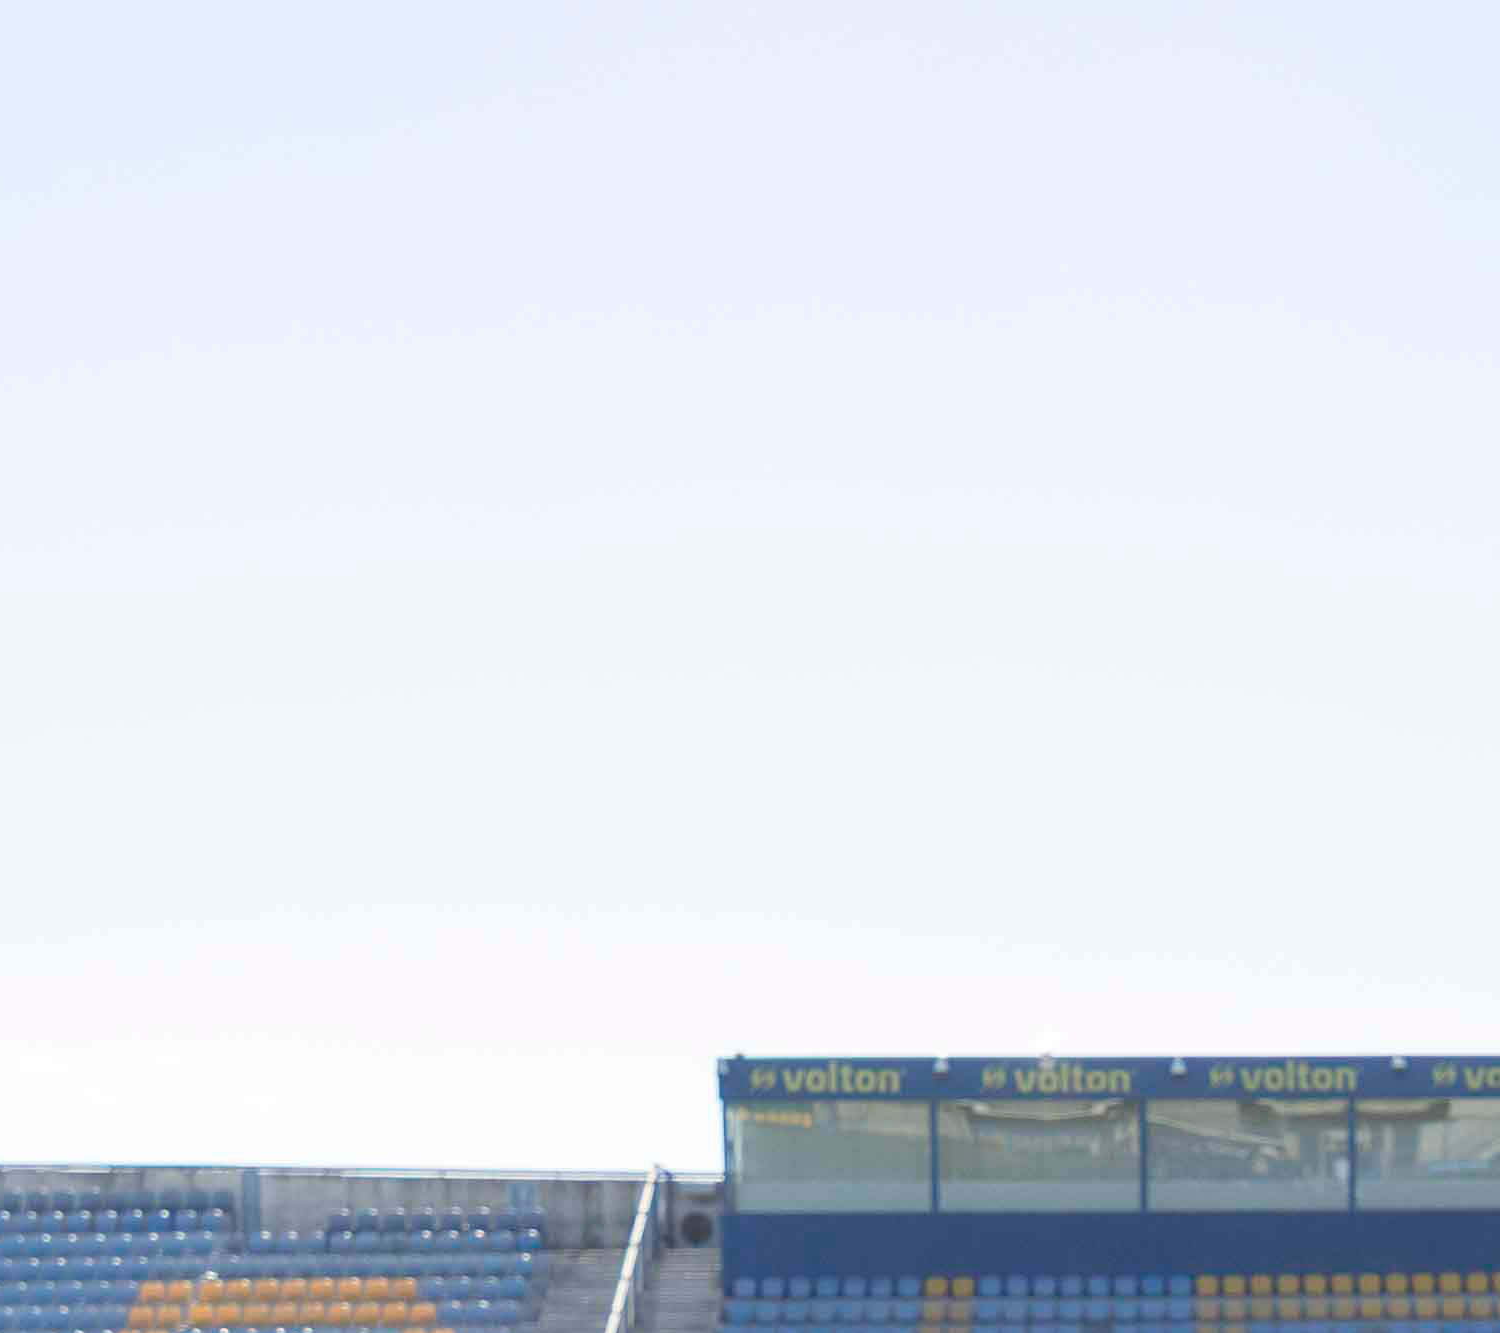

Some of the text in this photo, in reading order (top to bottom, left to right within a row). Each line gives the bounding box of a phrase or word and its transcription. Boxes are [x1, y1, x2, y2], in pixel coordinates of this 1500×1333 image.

[784, 1062, 899, 1093] volton
[1015, 1062, 1131, 1093] volton
[1244, 1060, 1357, 1091] volton
